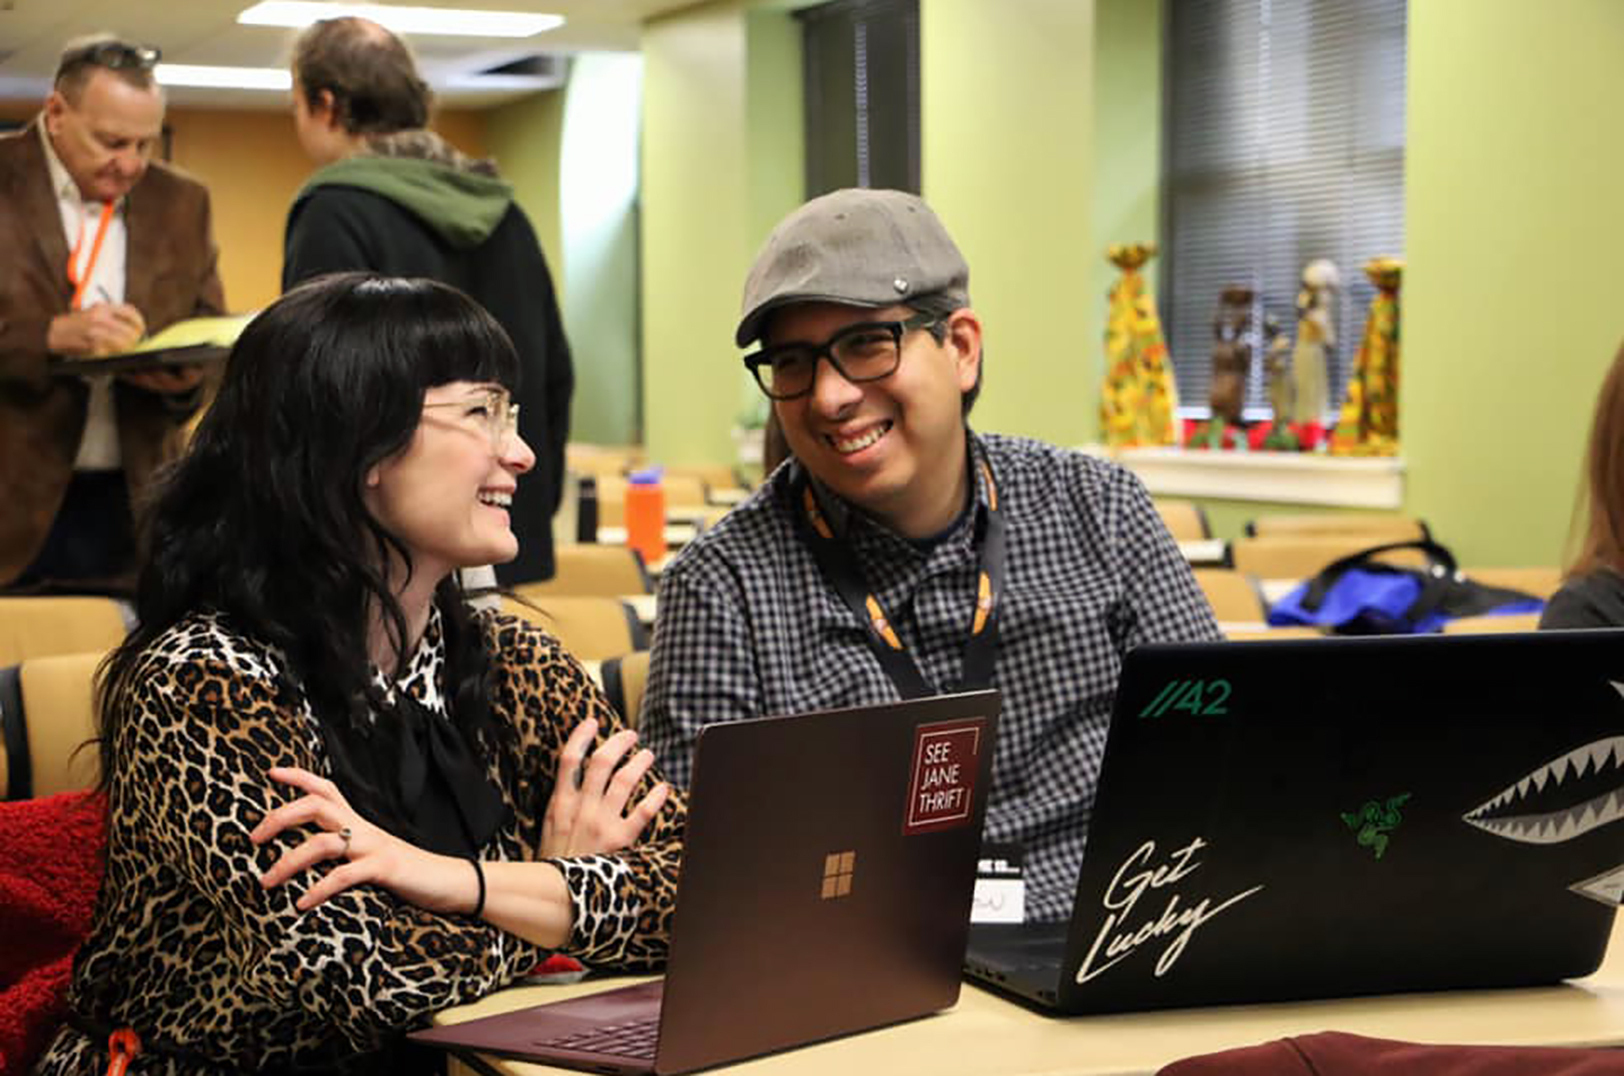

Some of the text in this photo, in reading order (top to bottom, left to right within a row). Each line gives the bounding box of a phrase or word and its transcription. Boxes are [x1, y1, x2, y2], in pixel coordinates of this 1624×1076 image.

[924, 742, 951, 763] SEE
[921, 764, 961, 790] JANE
[920, 787, 964, 813] THRIFT
[1103, 838, 1207, 926] Get
[1076, 885, 1264, 984] Lucky
